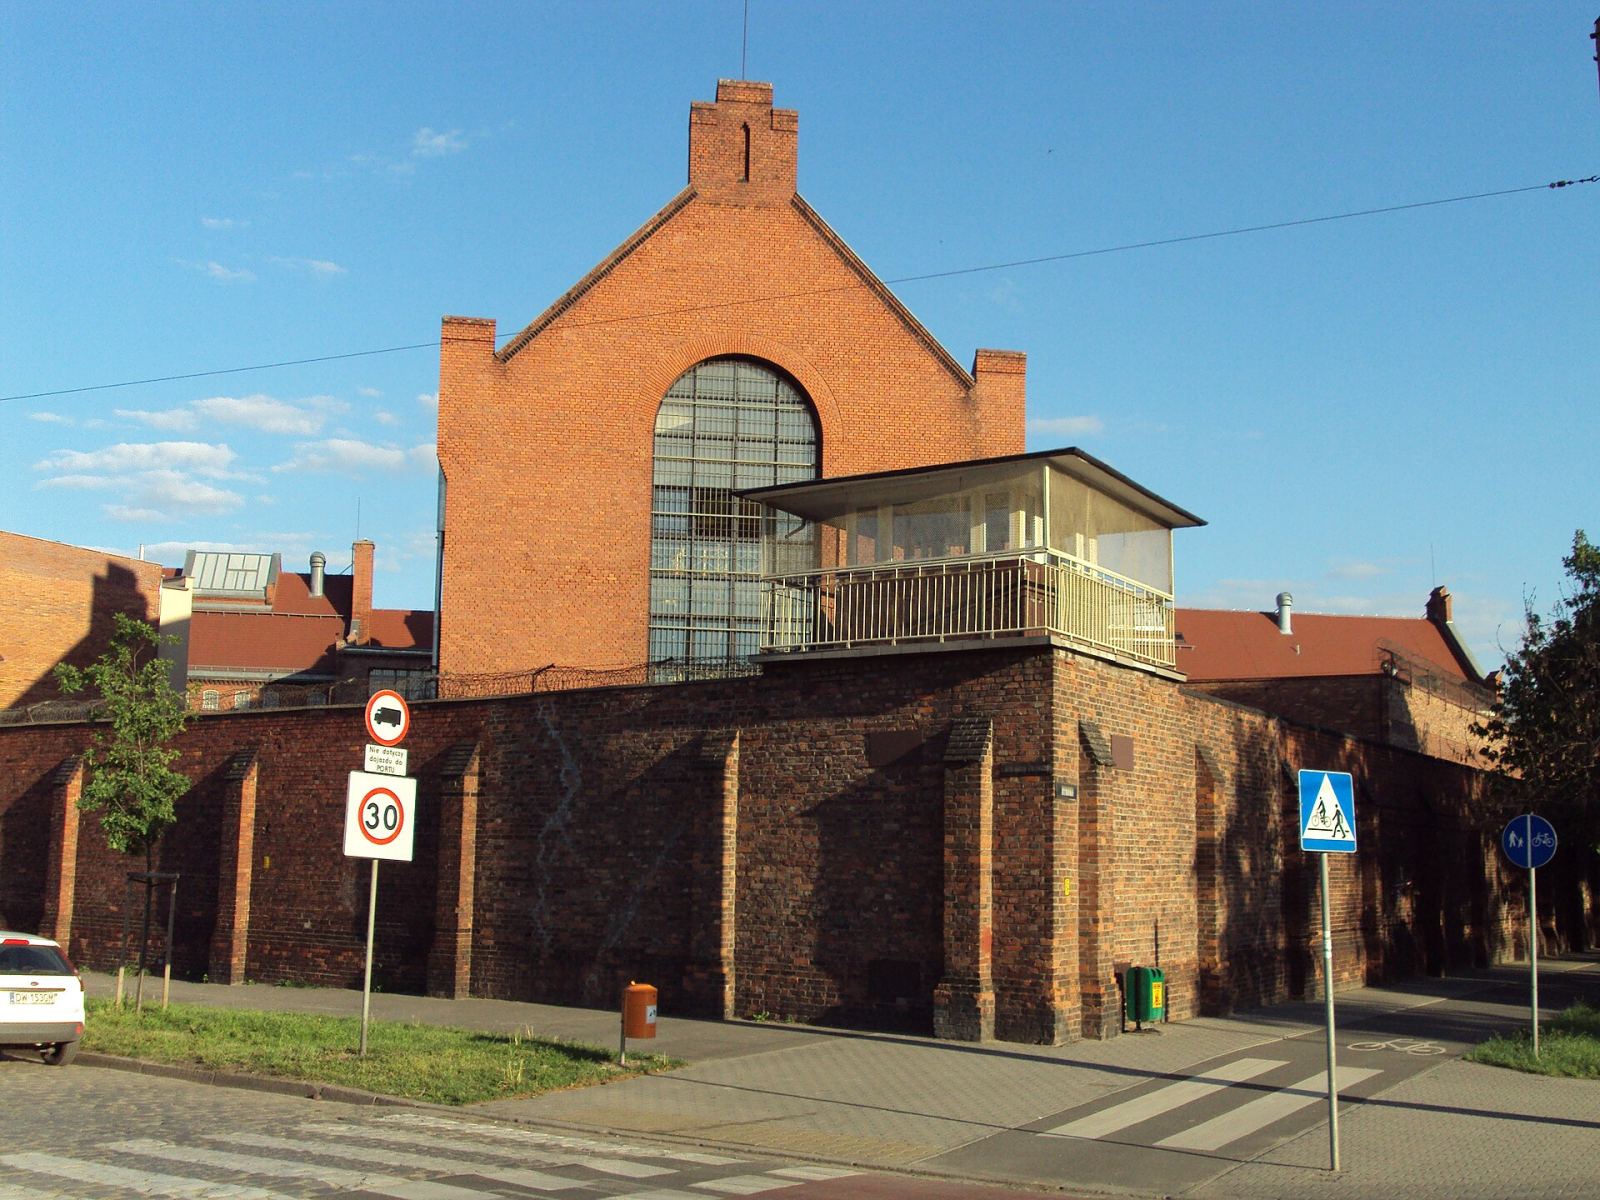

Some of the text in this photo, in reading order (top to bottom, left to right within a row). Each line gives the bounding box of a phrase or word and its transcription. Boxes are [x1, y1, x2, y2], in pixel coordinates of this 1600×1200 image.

[369, 746, 403, 758] Nie dotyczy
[369, 756, 392, 764] dojazdu
[376, 764, 395, 773] PORTU
[365, 802, 398, 830] 30
